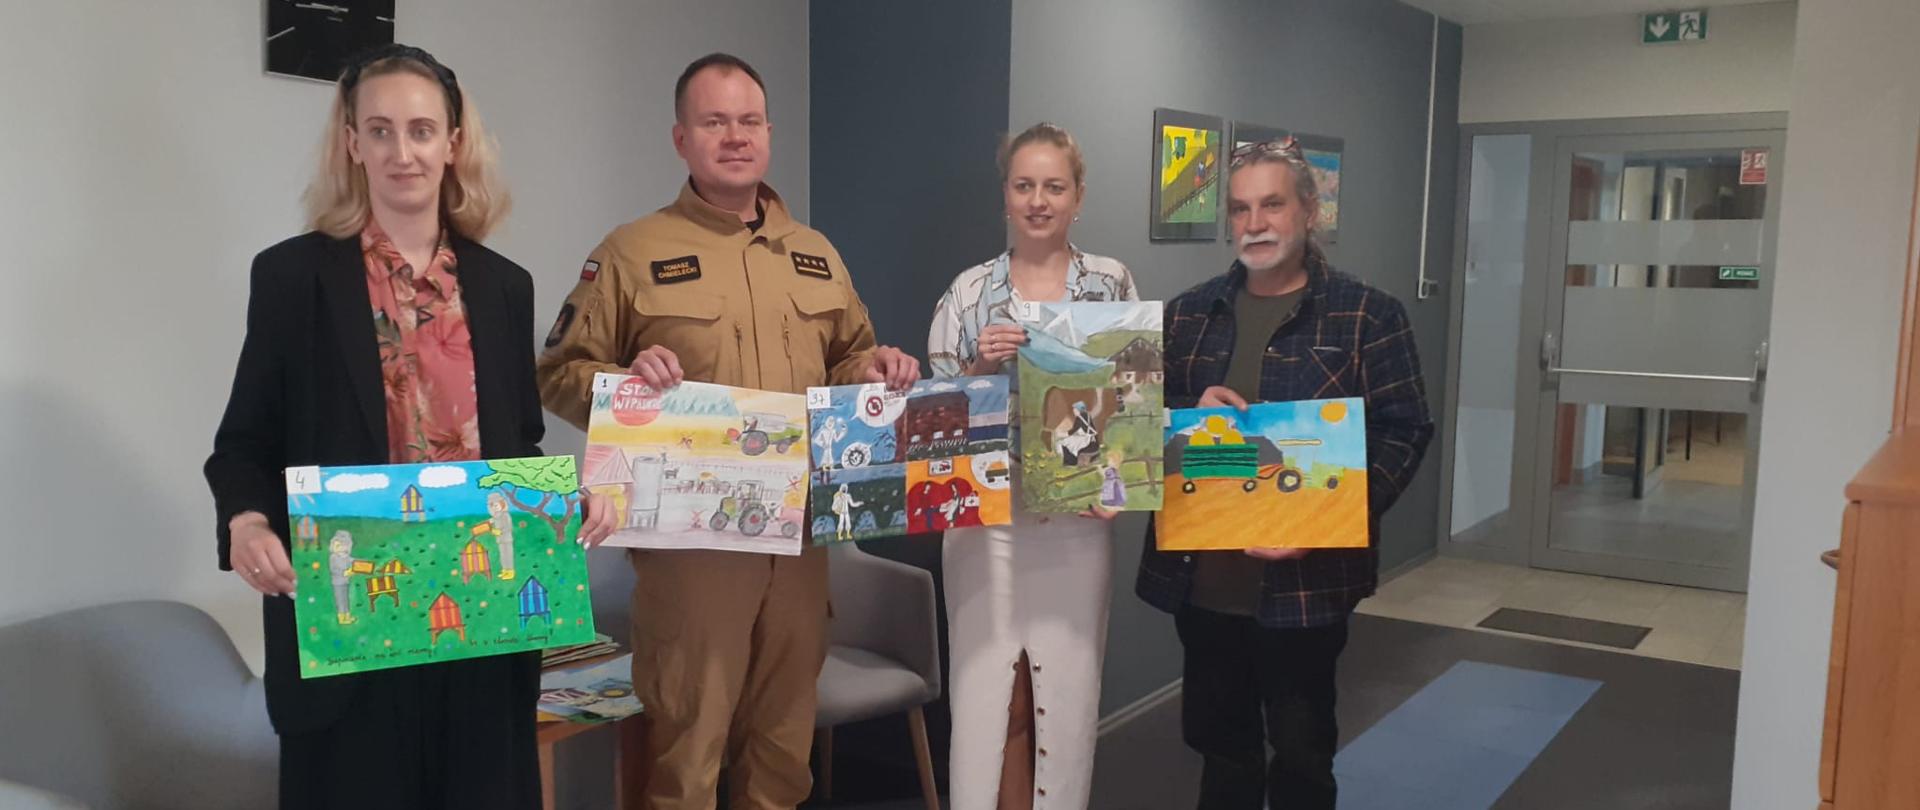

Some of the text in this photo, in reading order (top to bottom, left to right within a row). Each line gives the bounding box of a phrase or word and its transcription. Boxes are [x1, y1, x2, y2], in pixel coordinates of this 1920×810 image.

[601, 377, 608, 388] 1
[619, 383, 655, 397] STO
[295, 470, 304, 490] 4
